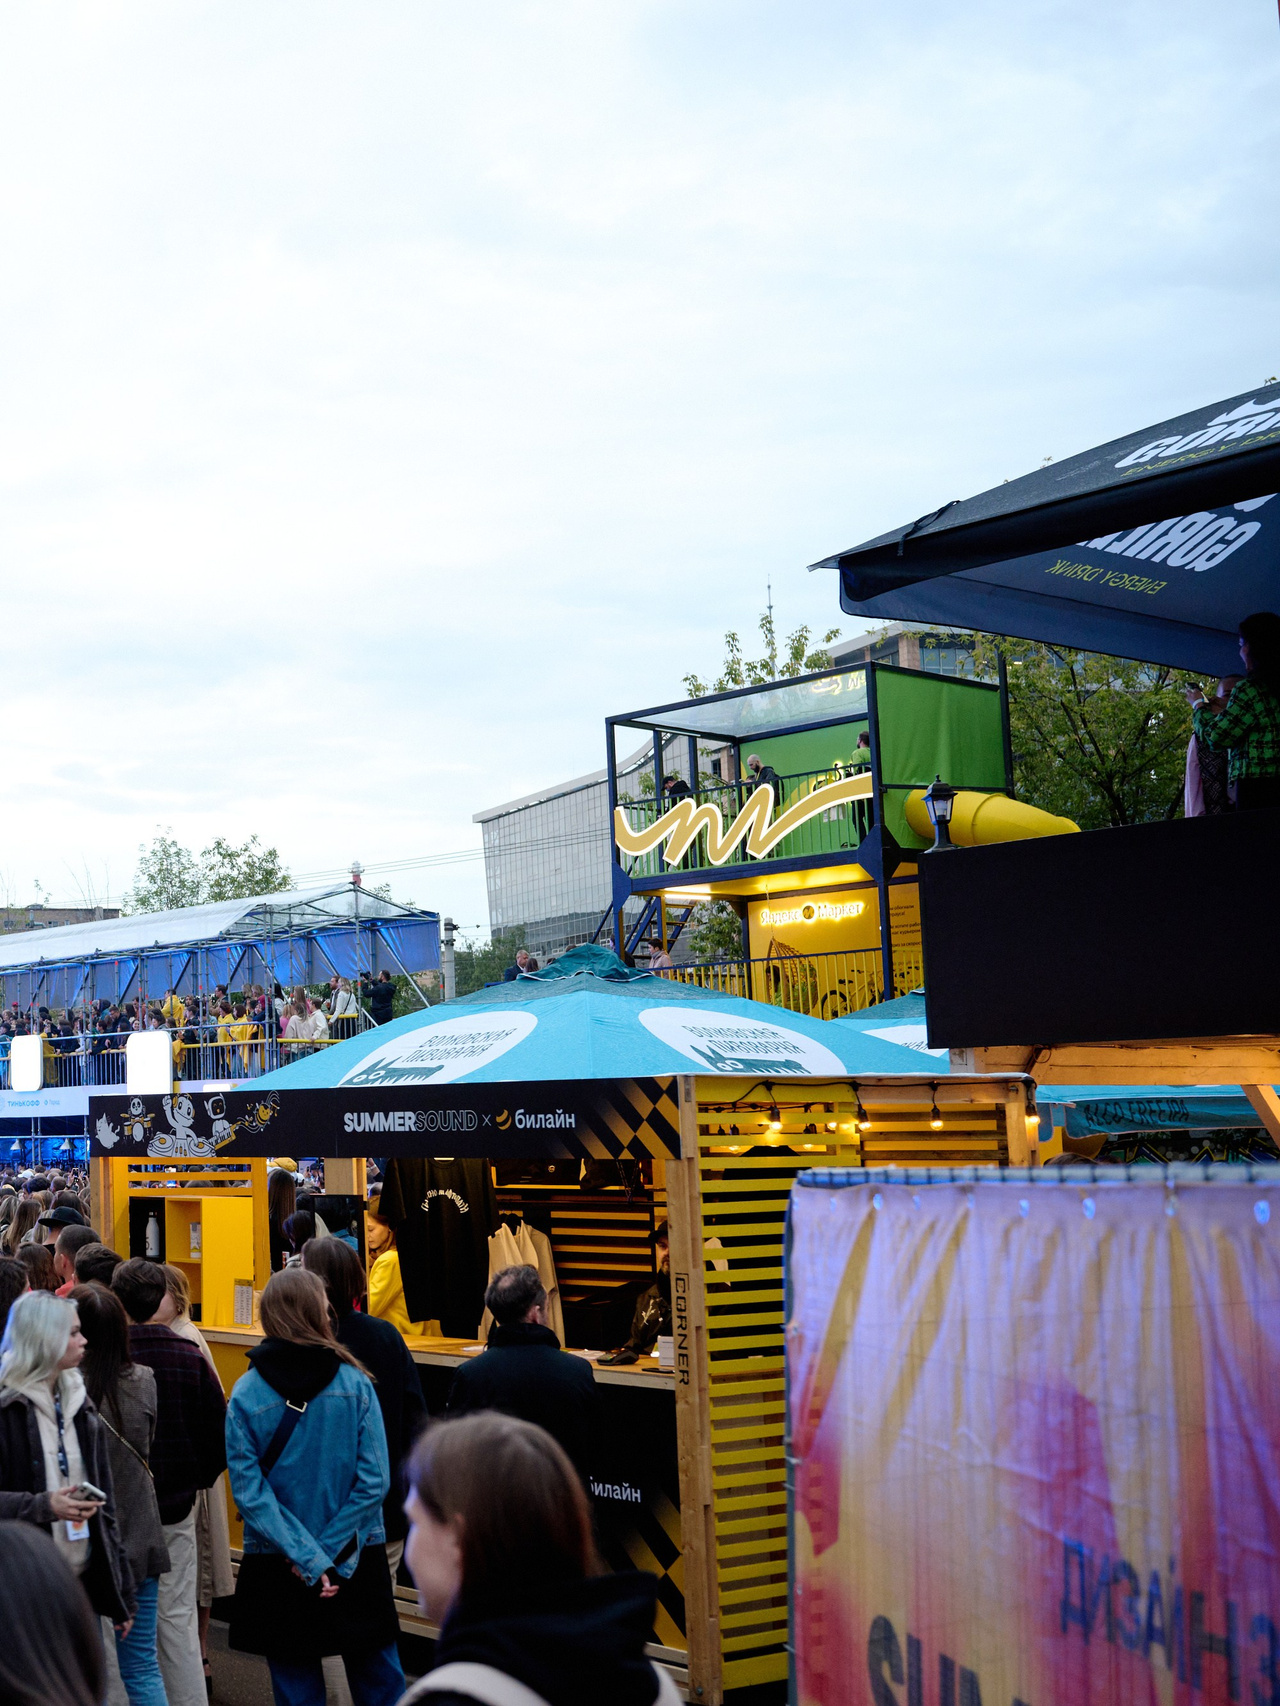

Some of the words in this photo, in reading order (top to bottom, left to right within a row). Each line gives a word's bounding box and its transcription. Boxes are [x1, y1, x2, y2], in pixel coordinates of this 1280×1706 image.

[7, 1099, 40, 1107] ТИНЬКОФФ
[344, 1110, 478, 1132] SUMMERSOUND
[515, 1104, 576, 1129] билайн
[675, 1276, 690, 1386] CORNER
[589, 1476, 641, 1503] илайн
